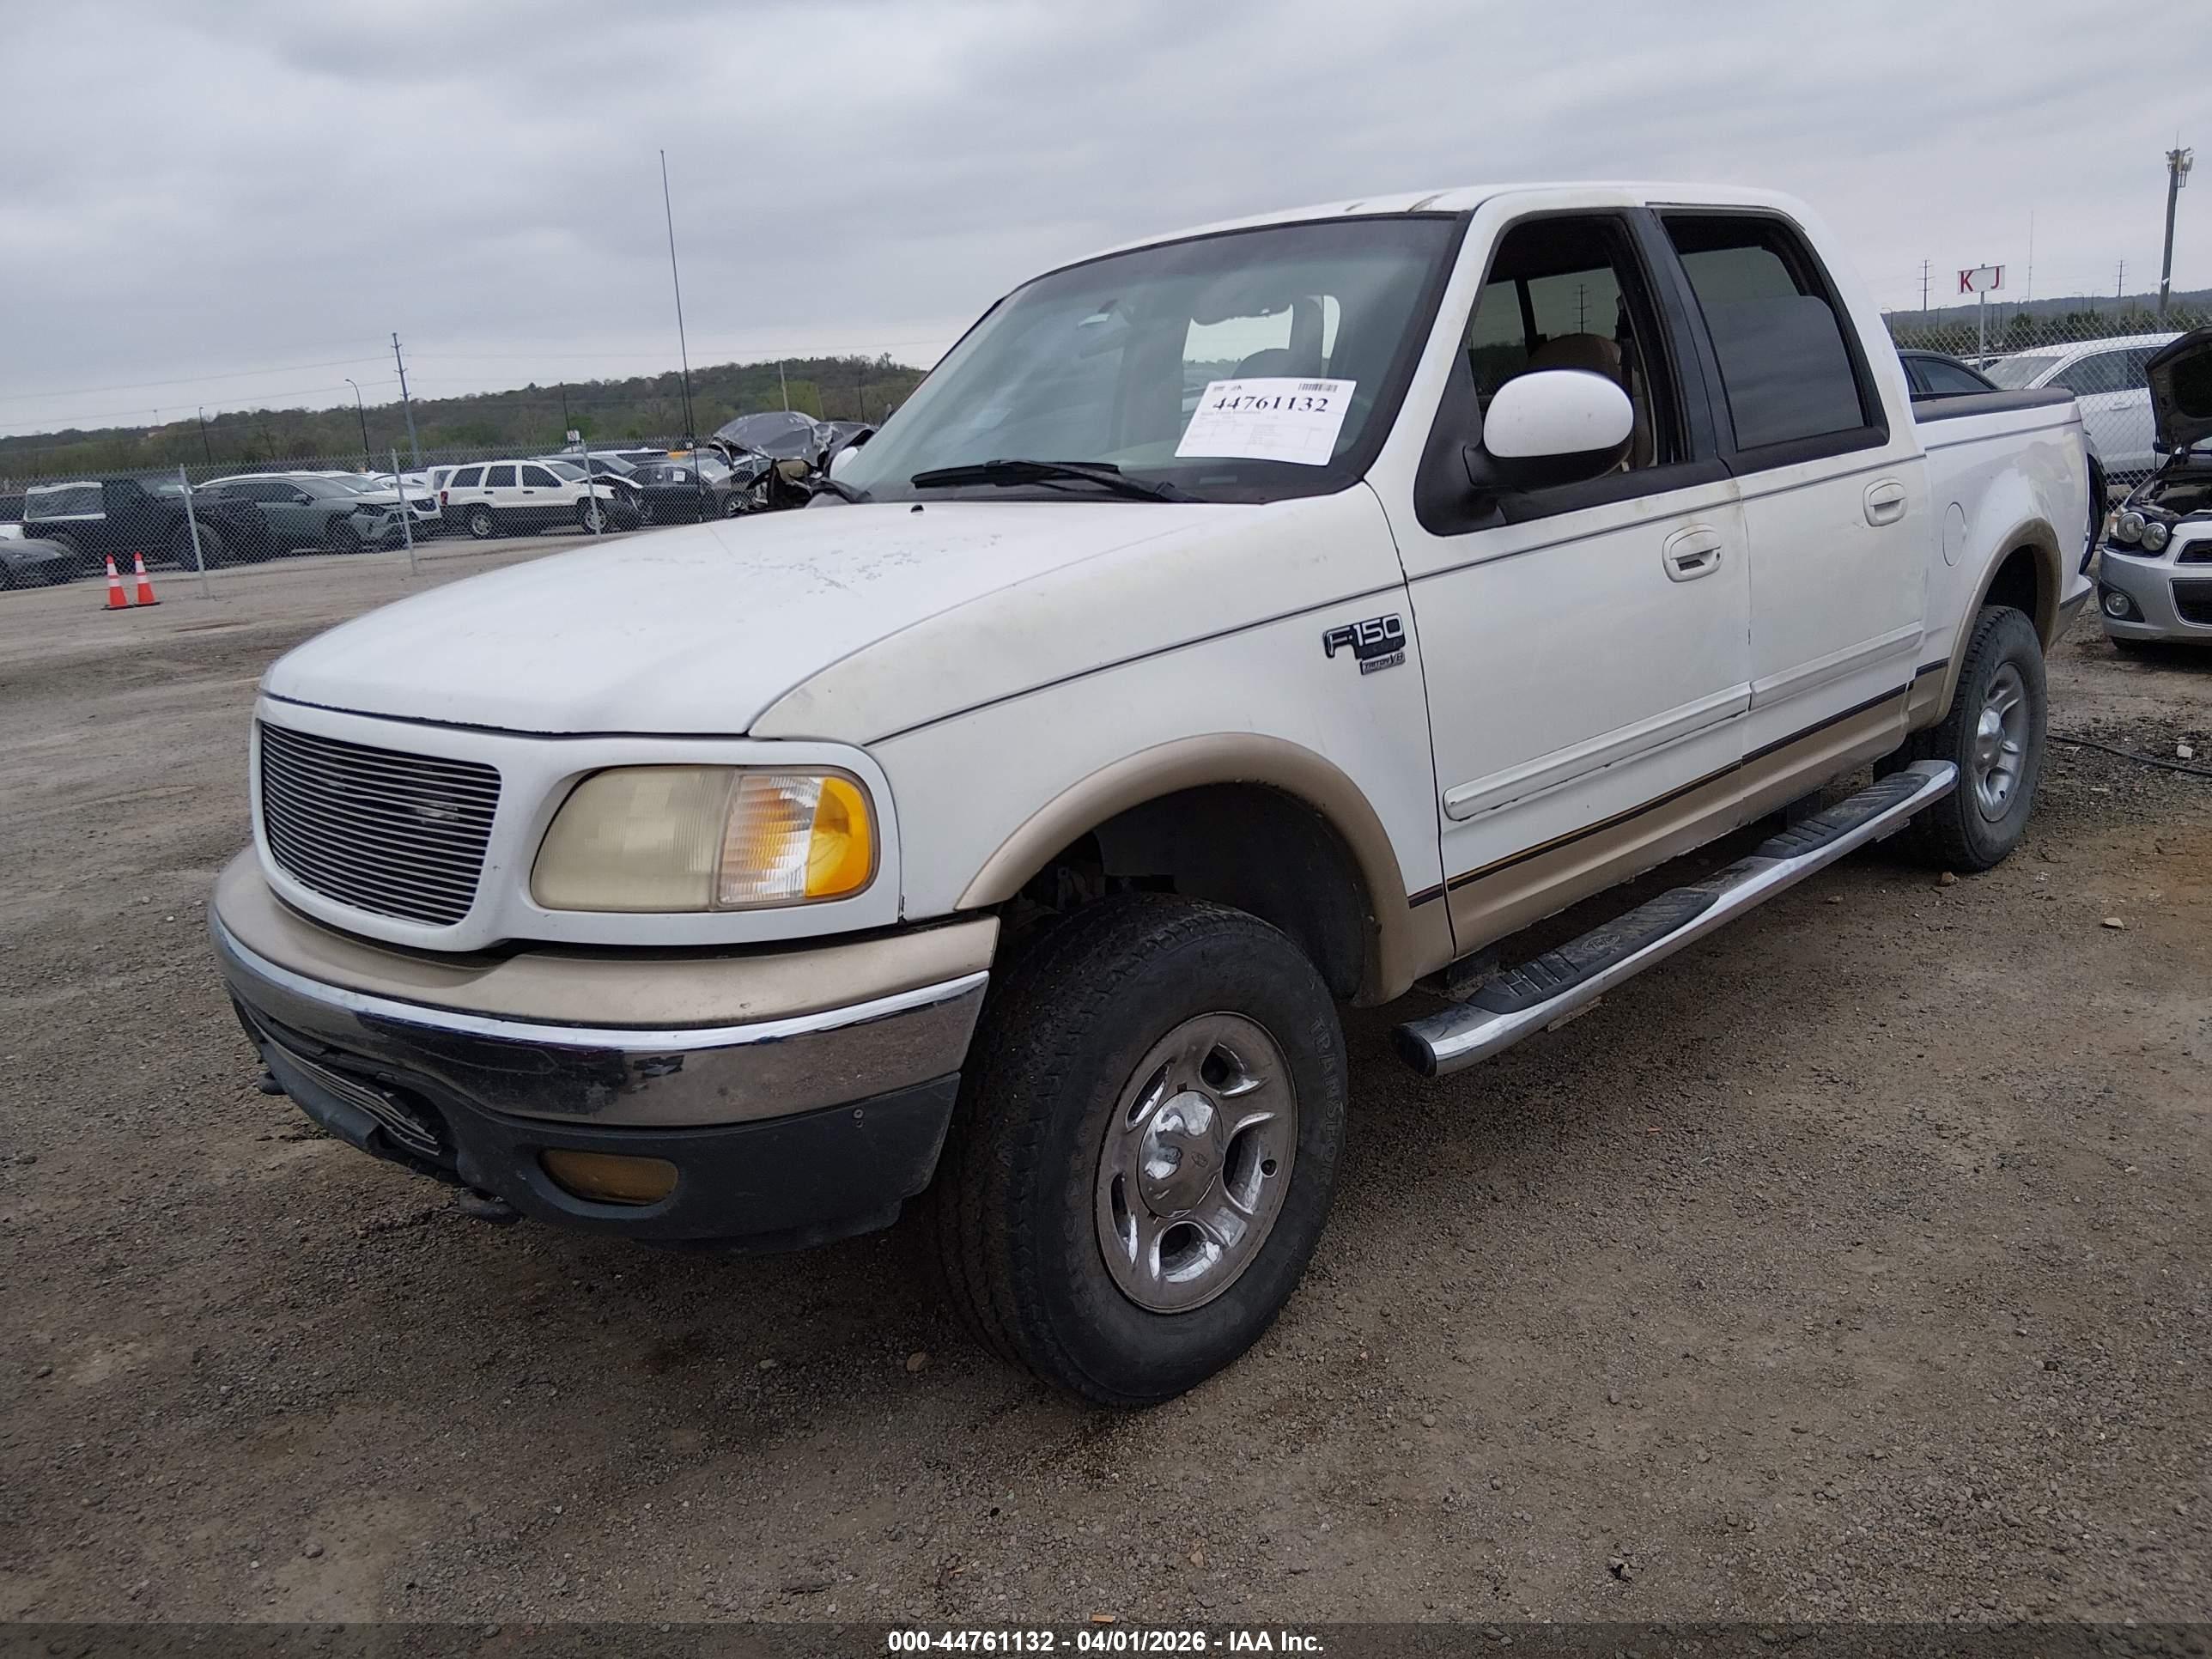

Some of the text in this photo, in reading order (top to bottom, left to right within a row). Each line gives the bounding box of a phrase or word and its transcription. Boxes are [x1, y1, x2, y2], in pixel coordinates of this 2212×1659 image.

[1960, 266, 2000, 293] K J
[1212, 396, 1328, 412] 44761132
